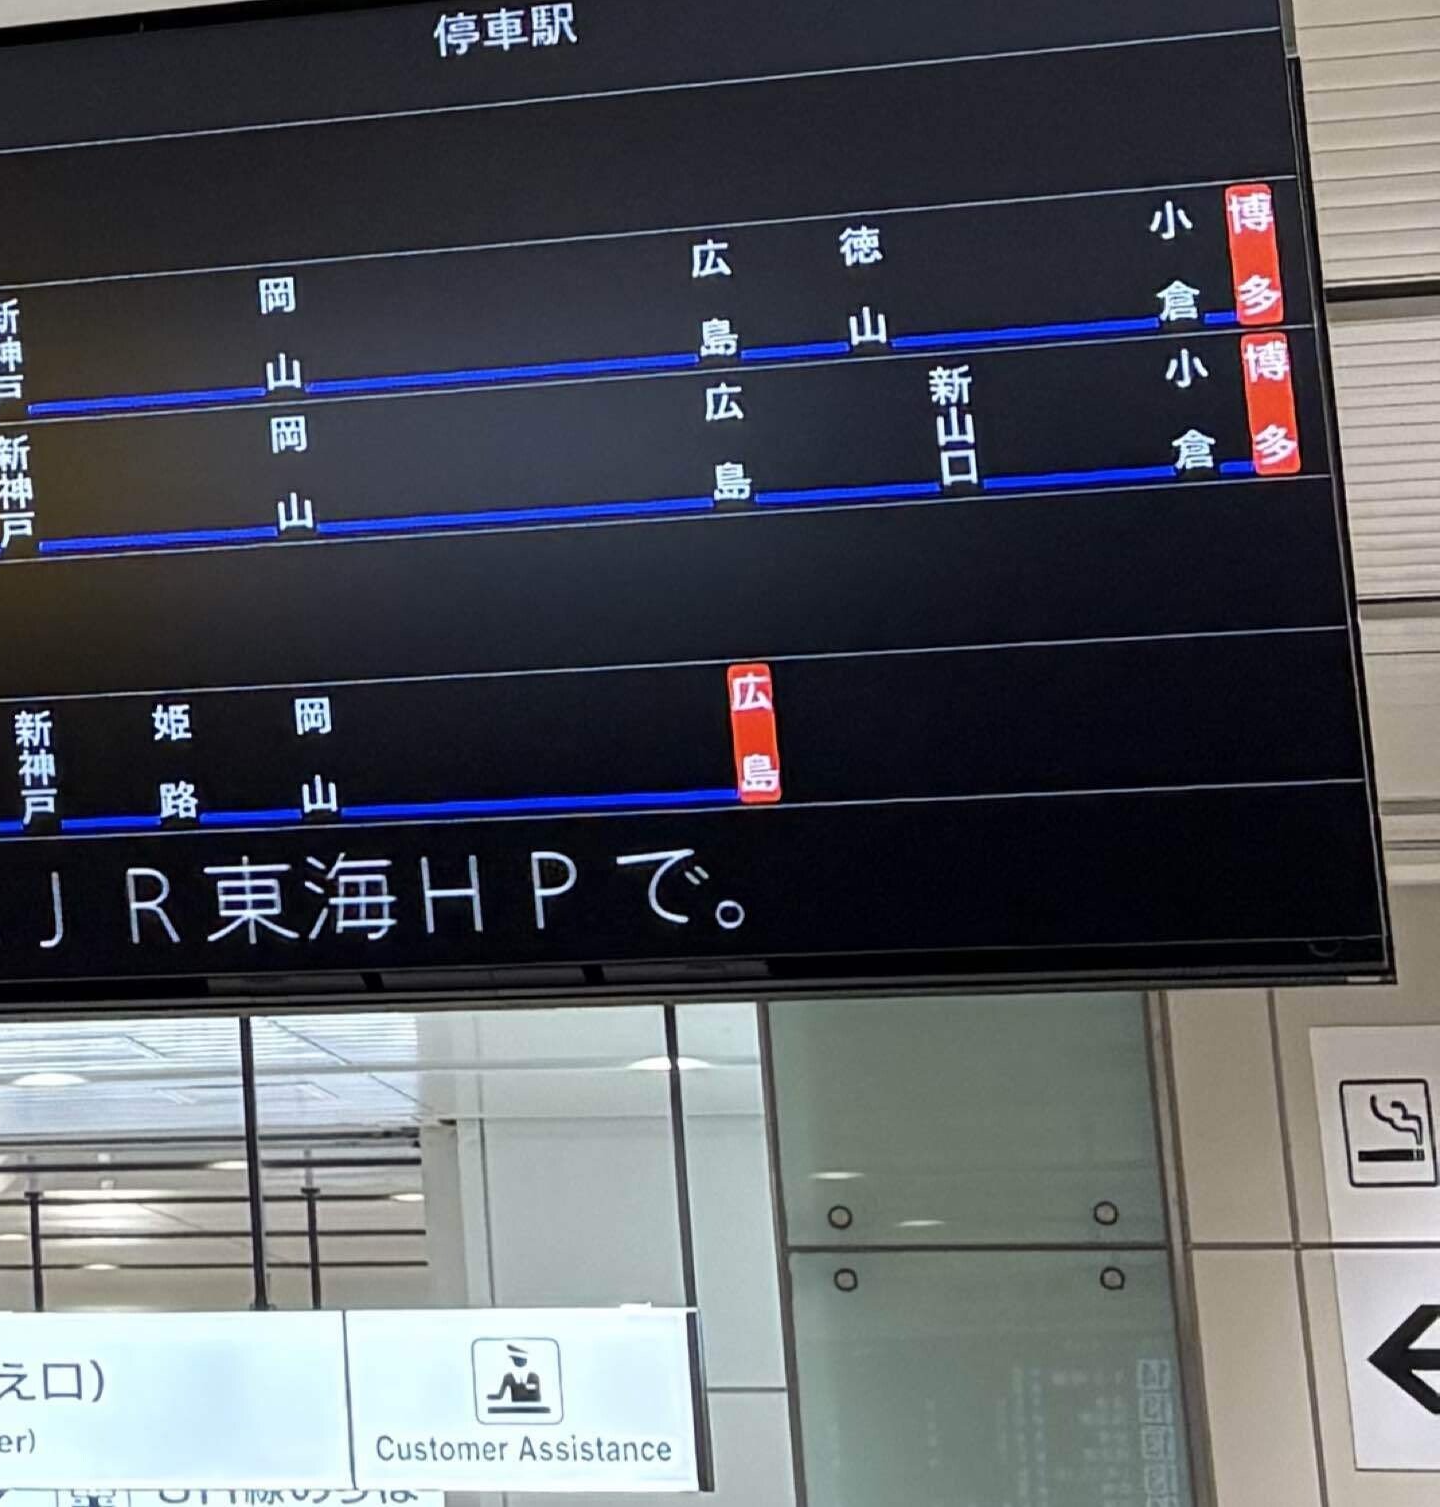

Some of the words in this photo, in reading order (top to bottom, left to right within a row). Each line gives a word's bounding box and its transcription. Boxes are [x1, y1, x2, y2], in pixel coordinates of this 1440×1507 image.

[434, 2, 578, 57] 停車駅
[375, 1434, 508, 1463] Customer
[518, 1432, 673, 1463] Assistance
